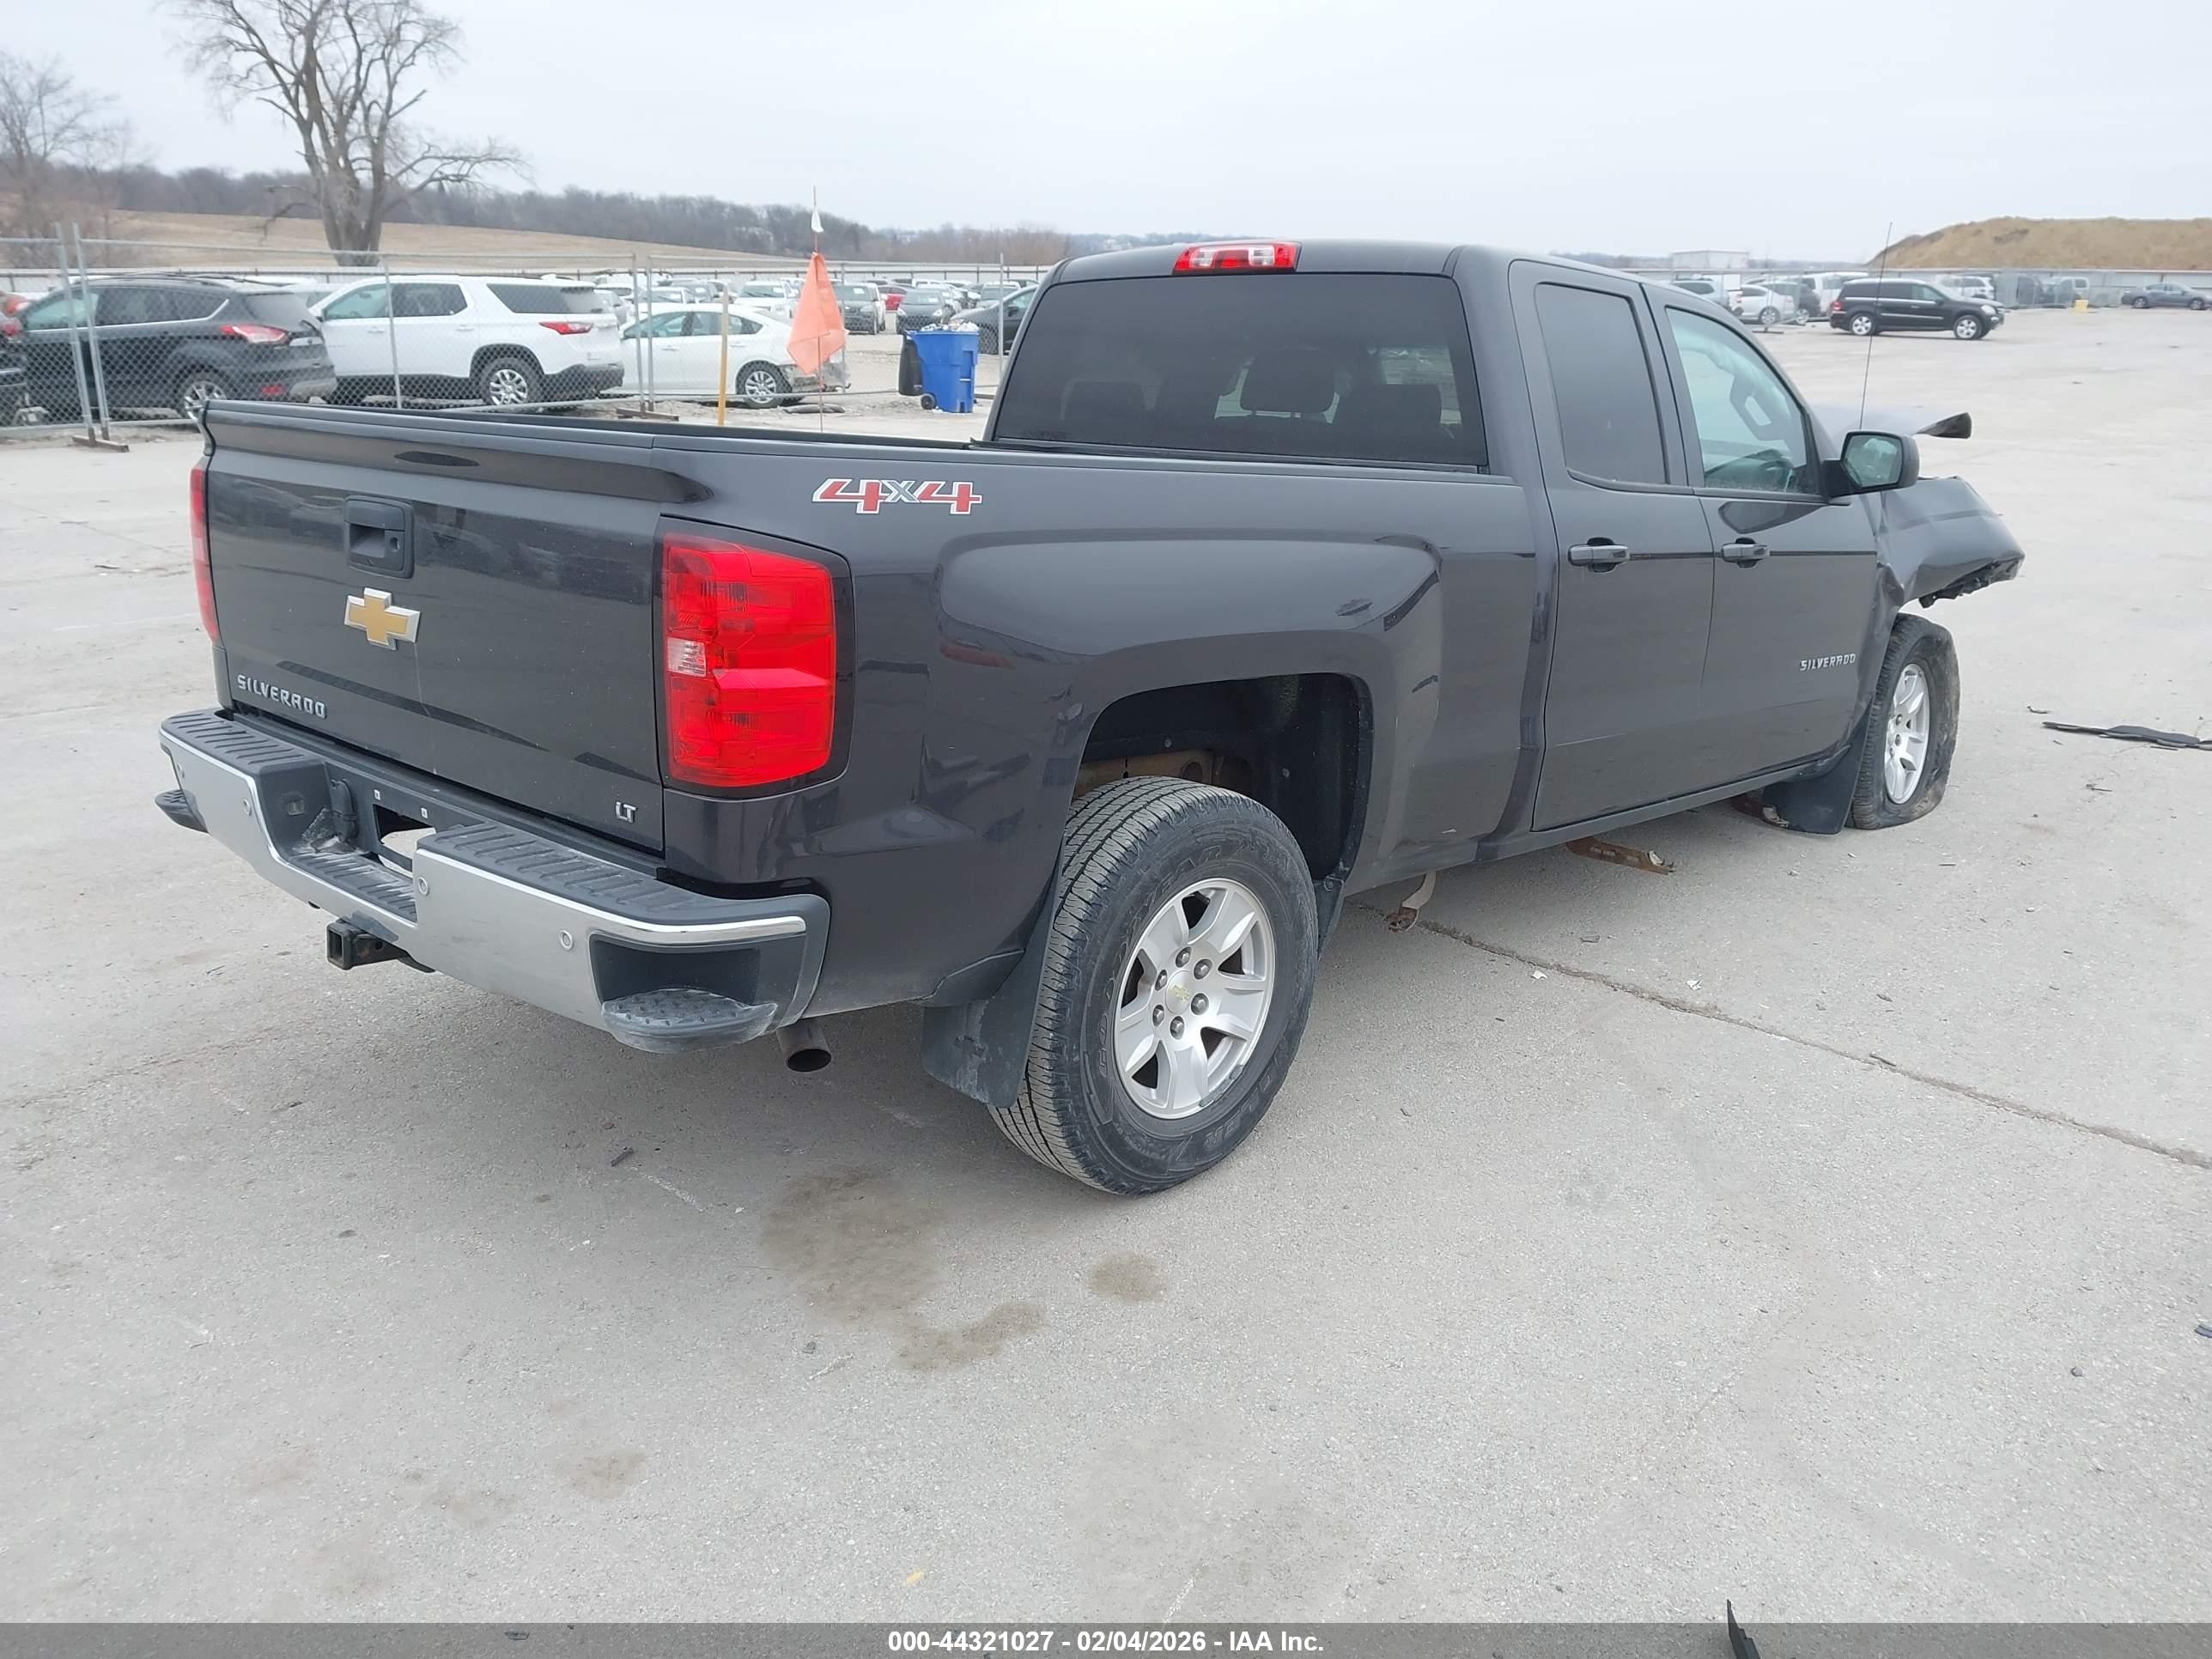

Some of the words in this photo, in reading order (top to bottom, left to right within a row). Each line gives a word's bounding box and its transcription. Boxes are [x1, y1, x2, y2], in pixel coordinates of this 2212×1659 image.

[1799, 653, 1856, 671] SILVERADO
[237, 674, 326, 719] SILVERADO
[616, 801, 636, 823] LT
